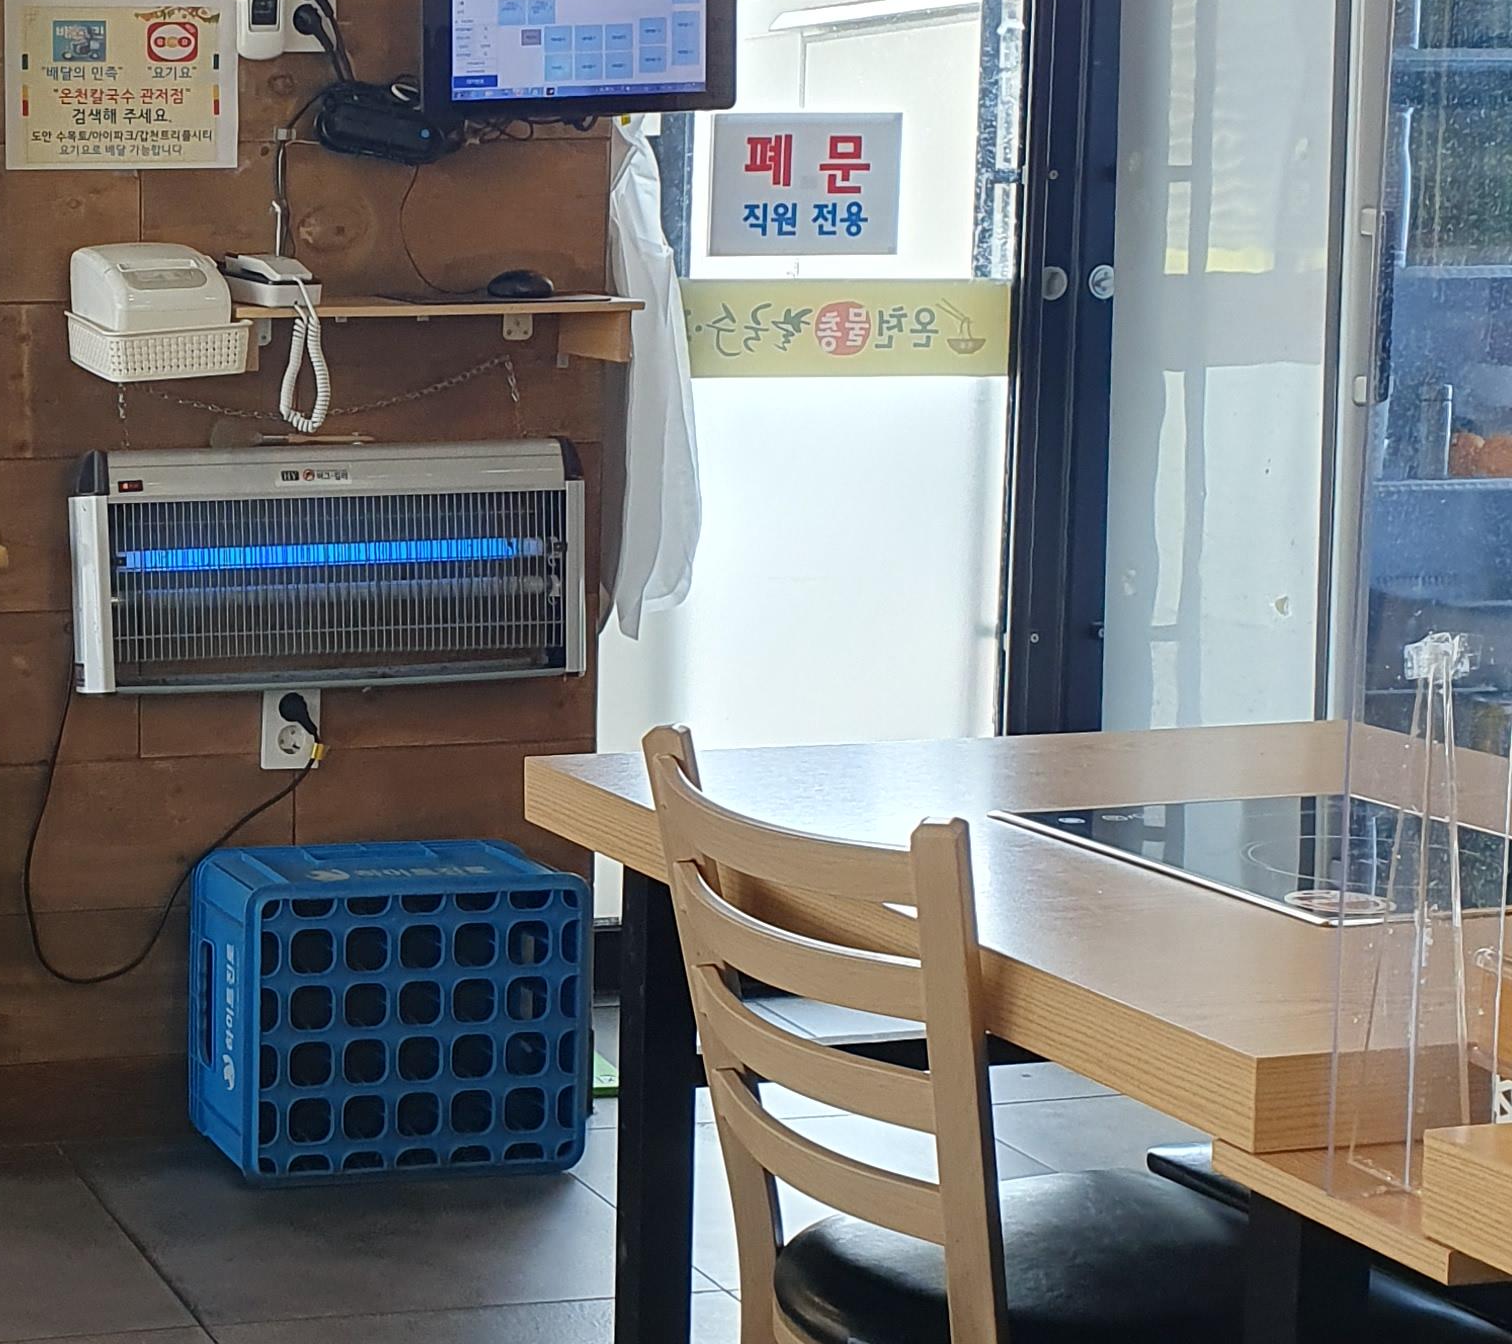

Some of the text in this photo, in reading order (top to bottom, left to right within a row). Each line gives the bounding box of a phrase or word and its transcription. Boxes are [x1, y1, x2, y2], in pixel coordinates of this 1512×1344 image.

[72, 108, 173, 125] 검색해 주세요.
[31, 130, 53, 143] 도안
[742, 200, 870, 238] 직원 전용
